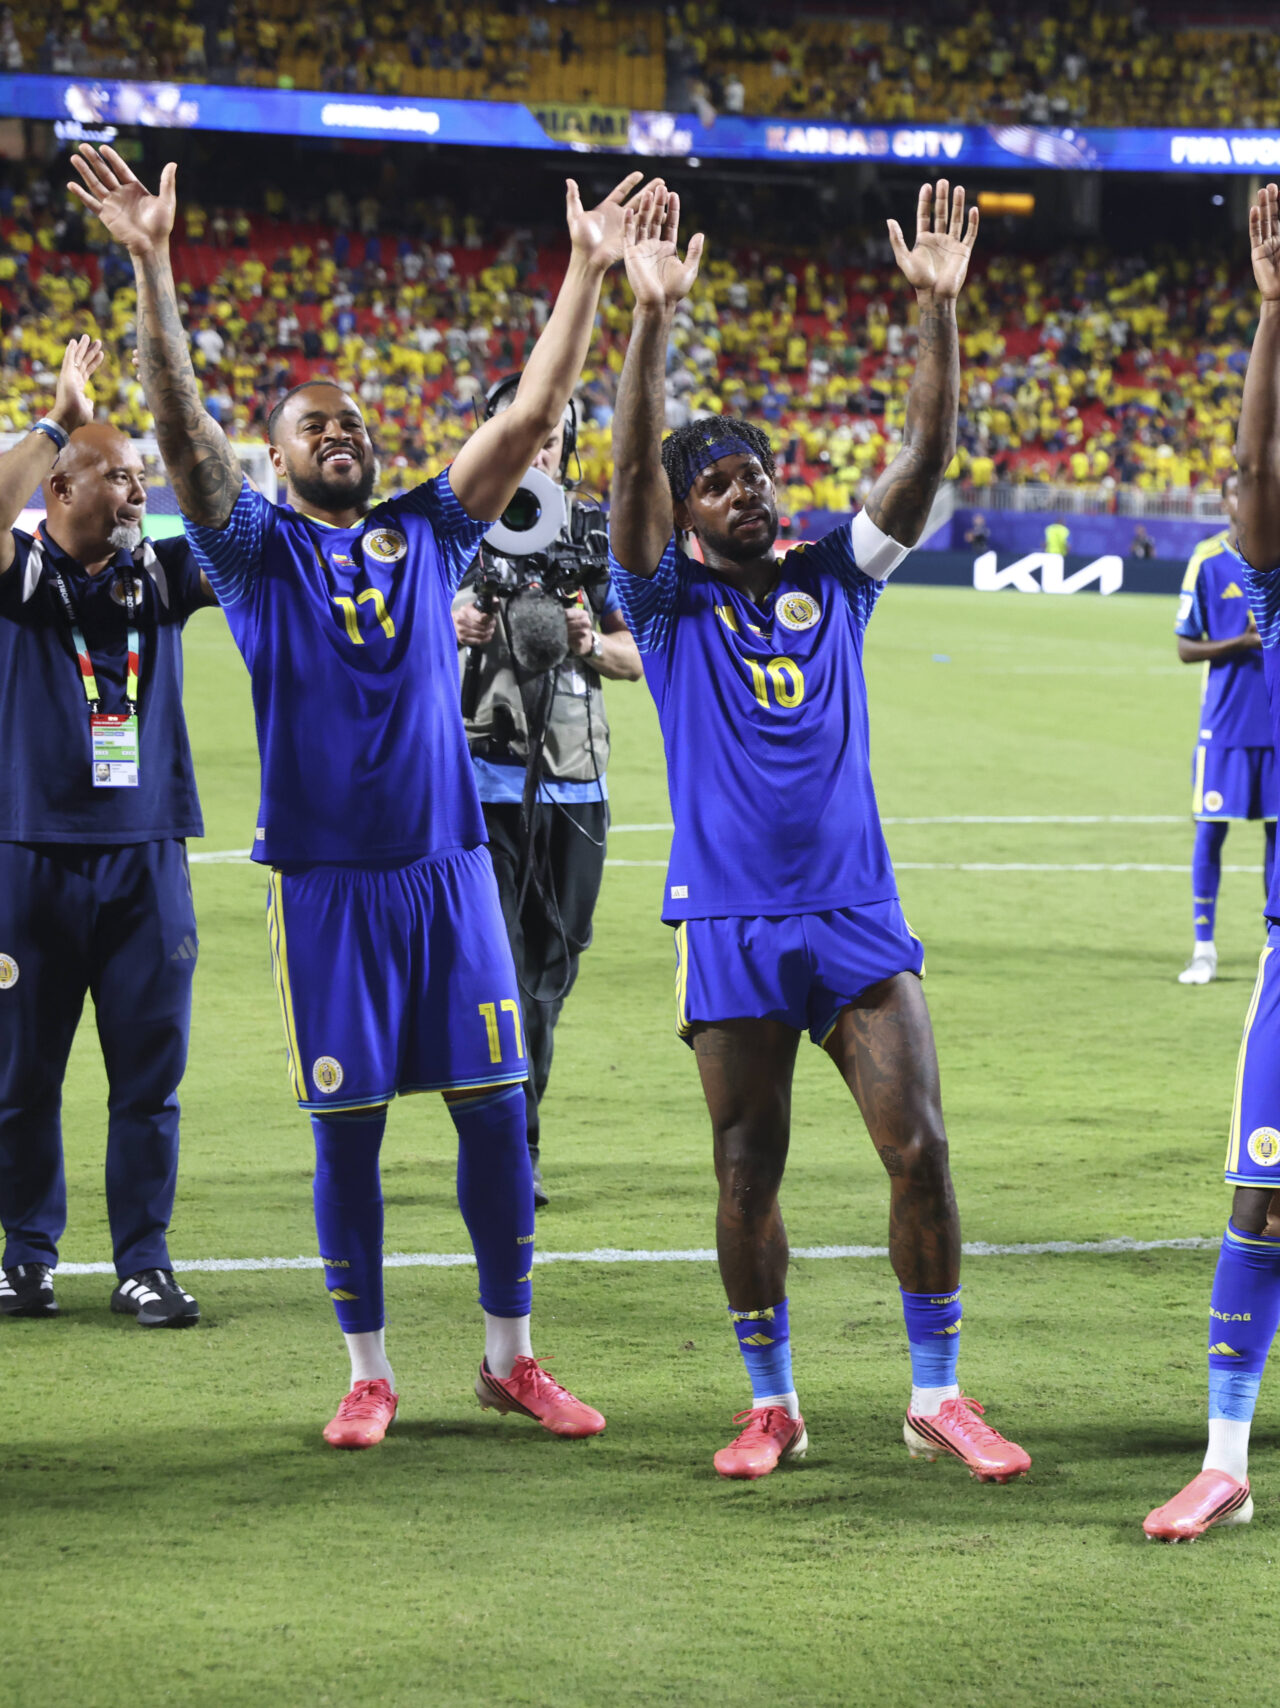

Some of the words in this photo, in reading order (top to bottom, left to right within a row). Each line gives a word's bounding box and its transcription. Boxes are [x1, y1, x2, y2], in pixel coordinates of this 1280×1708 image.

[892, 130, 963, 158] CITY
[1171, 137, 1232, 164] FIFA
[334, 588, 395, 644] 17
[742, 657, 805, 708] 10
